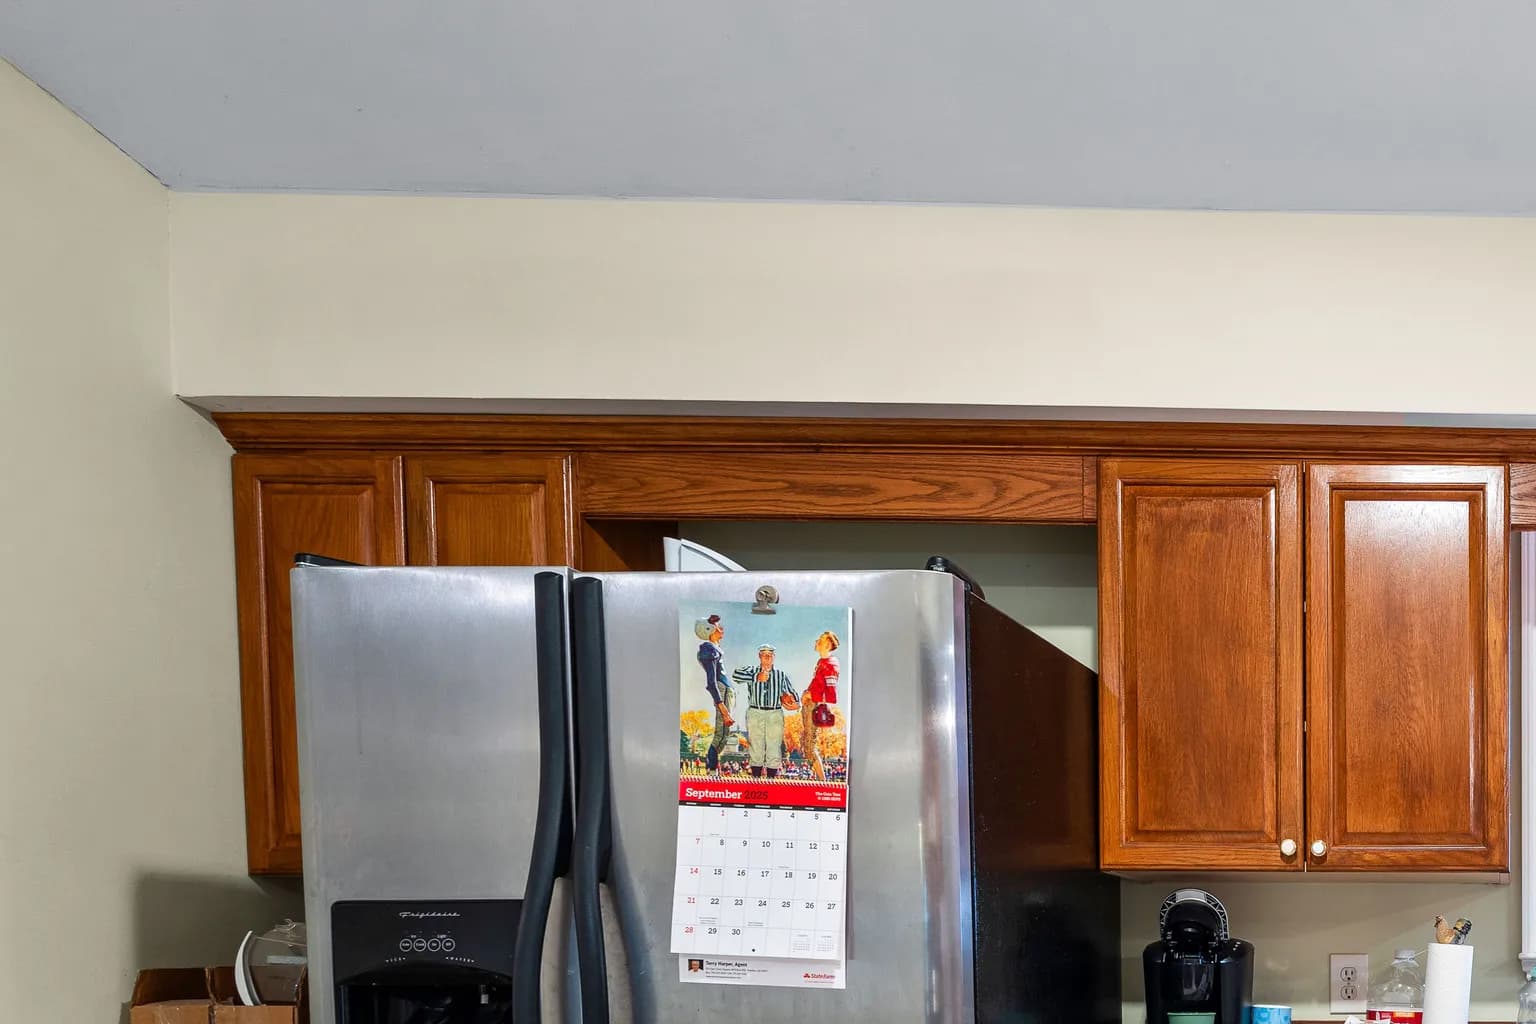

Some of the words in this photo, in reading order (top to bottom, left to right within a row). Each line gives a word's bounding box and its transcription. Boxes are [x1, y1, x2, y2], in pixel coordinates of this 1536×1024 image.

[685, 788, 743, 799] September
[744, 791, 769, 800] 2025
[761, 840, 771, 848] 10
[786, 841, 794, 849] 11
[809, 842, 818, 850] 12
[831, 843, 840, 851] 13
[713, 868, 722, 876] 15
[737, 869, 746, 877] 16
[761, 870, 770, 878] 17
[785, 871, 793, 879] 18
[807, 872, 817, 880] 19
[828, 873, 838, 881] 20
[687, 896, 696, 904] 21
[710, 897, 720, 905] 22
[734, 898, 744, 906] 23
[758, 899, 767, 907] 24
[781, 900, 791, 908] 25
[804, 902, 815, 910] 26
[684, 926, 694, 934] 28
[707, 927, 718, 935] 29
[731, 928, 741, 936] 30
